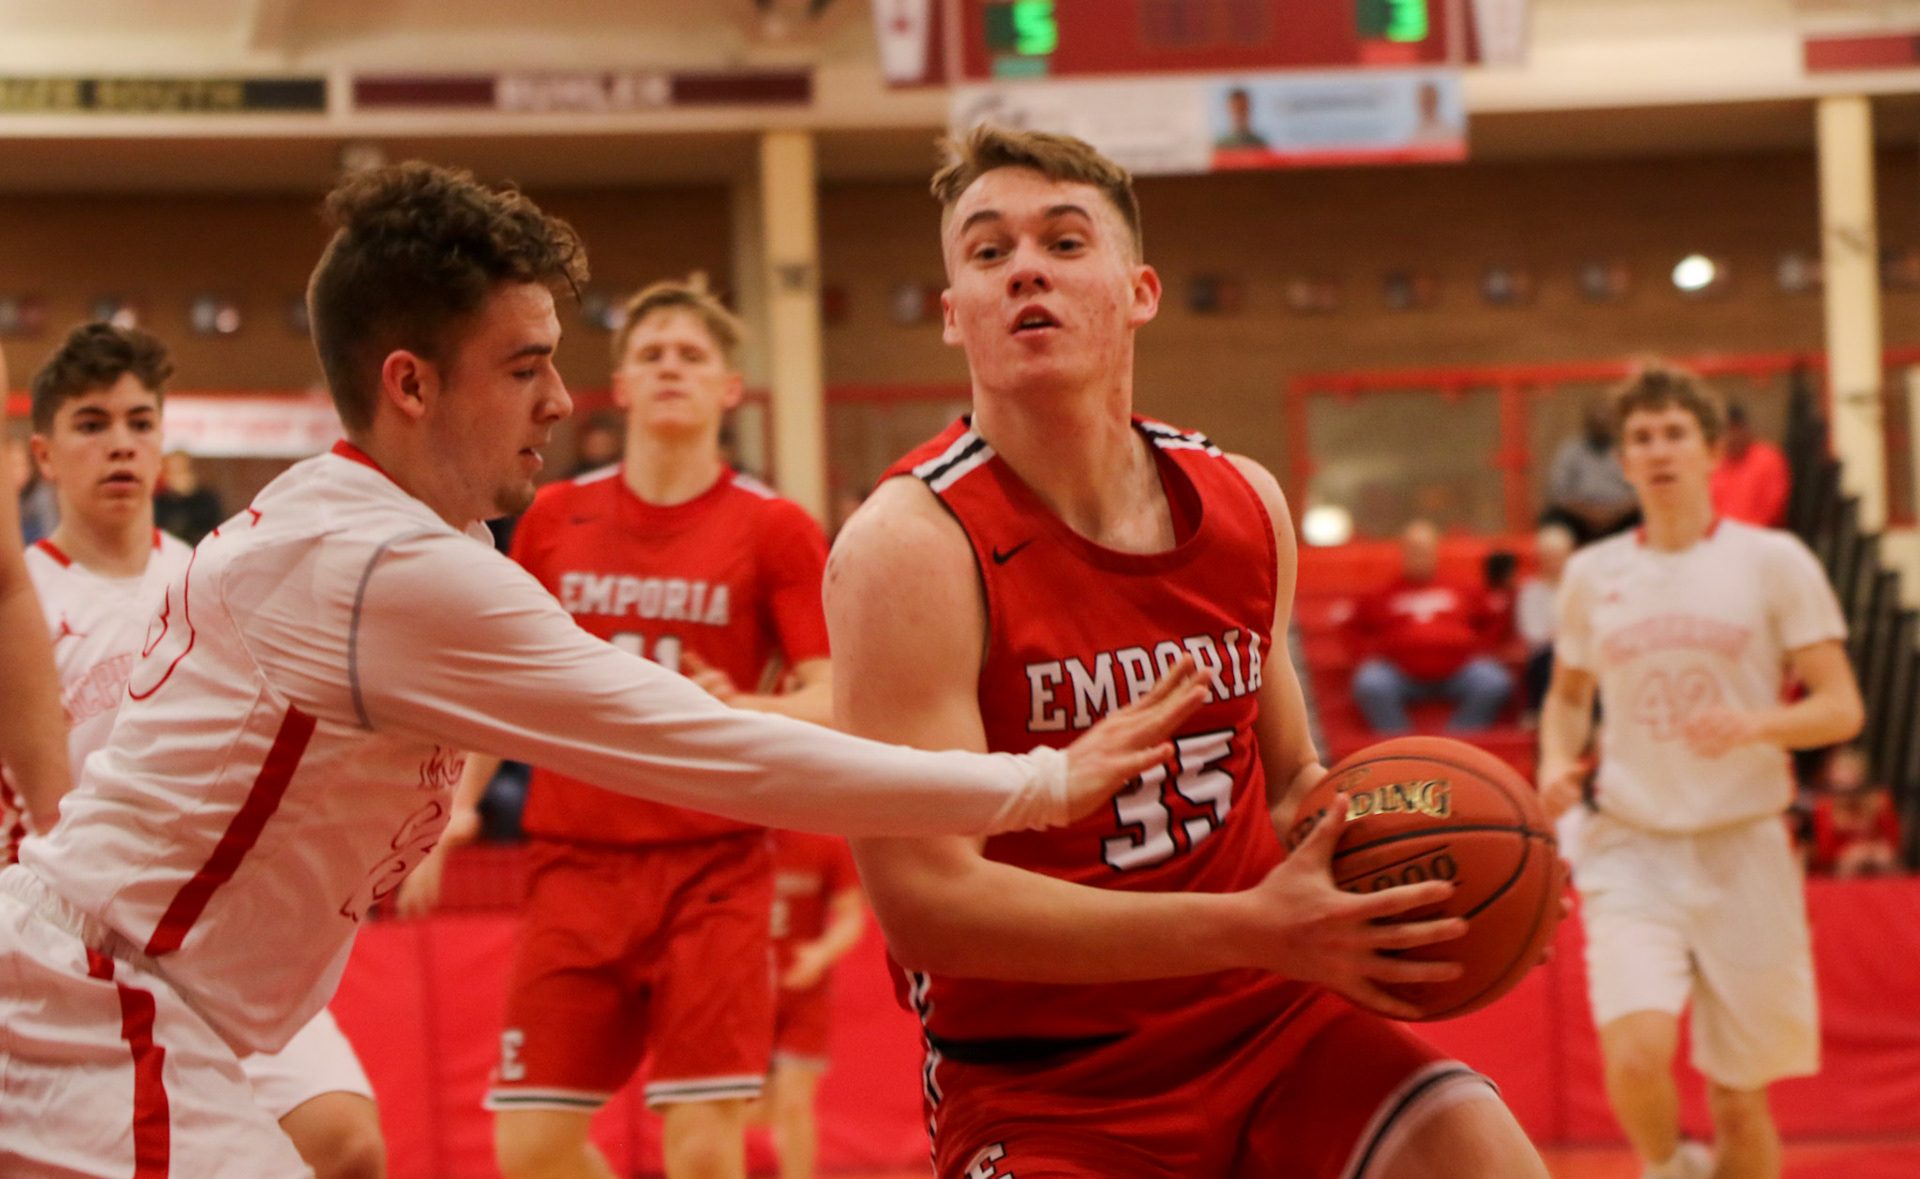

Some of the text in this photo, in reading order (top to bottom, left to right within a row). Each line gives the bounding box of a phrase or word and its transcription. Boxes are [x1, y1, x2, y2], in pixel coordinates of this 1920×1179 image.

[560, 571, 731, 627] EMPORIA
[1025, 627, 1263, 733] EMPORIA
[1101, 728, 1237, 870] 35
[501, 1028, 526, 1081] E
